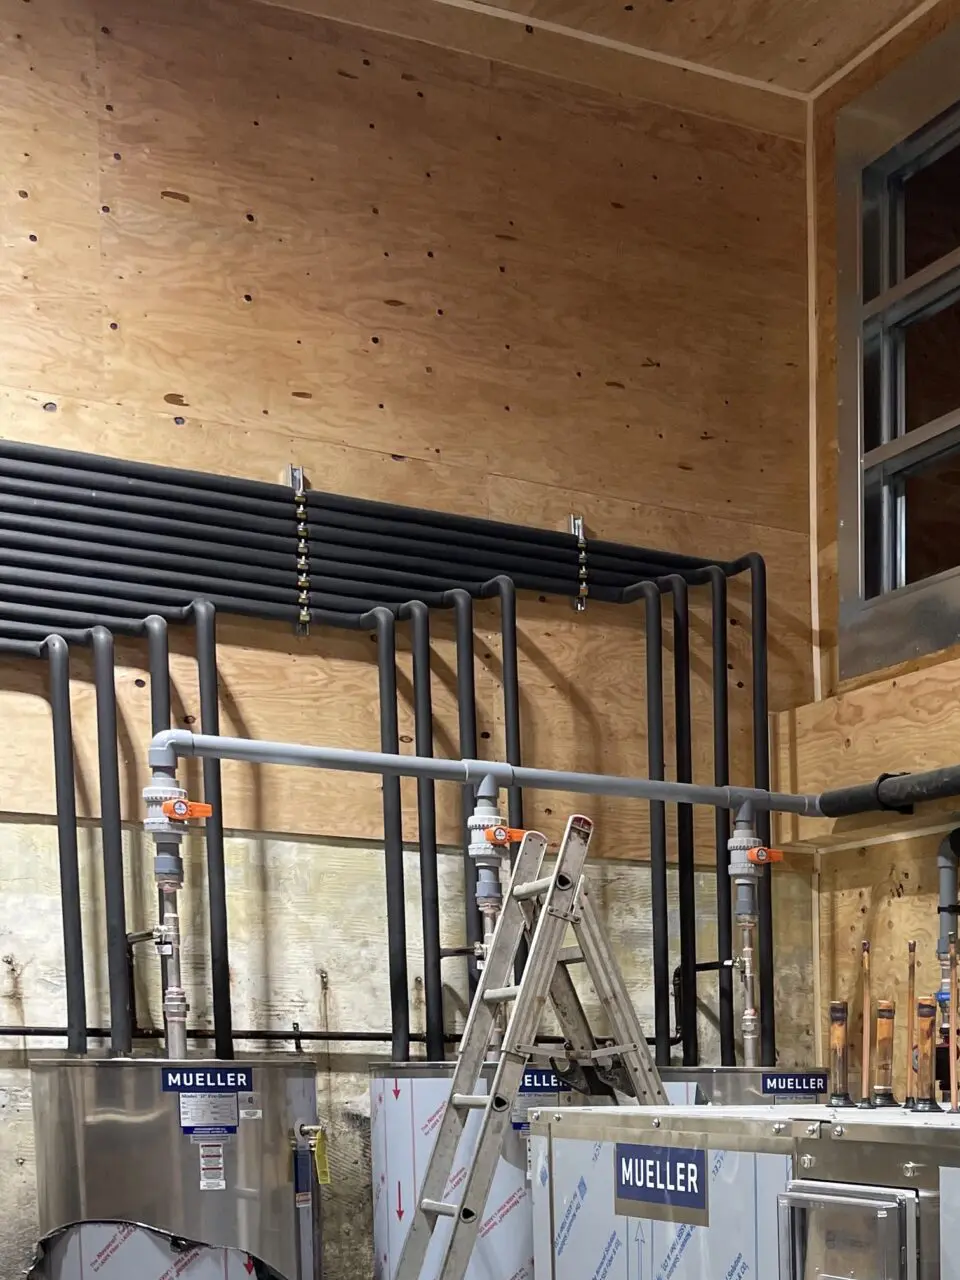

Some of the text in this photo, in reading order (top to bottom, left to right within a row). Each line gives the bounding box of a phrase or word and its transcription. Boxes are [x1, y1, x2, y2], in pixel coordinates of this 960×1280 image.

[168, 1073, 248, 1086] MUELLER
[520, 1074, 567, 1086] ELLE
[766, 1078, 824, 1089] MUELLER
[621, 1156, 699, 1194] MUELLER
